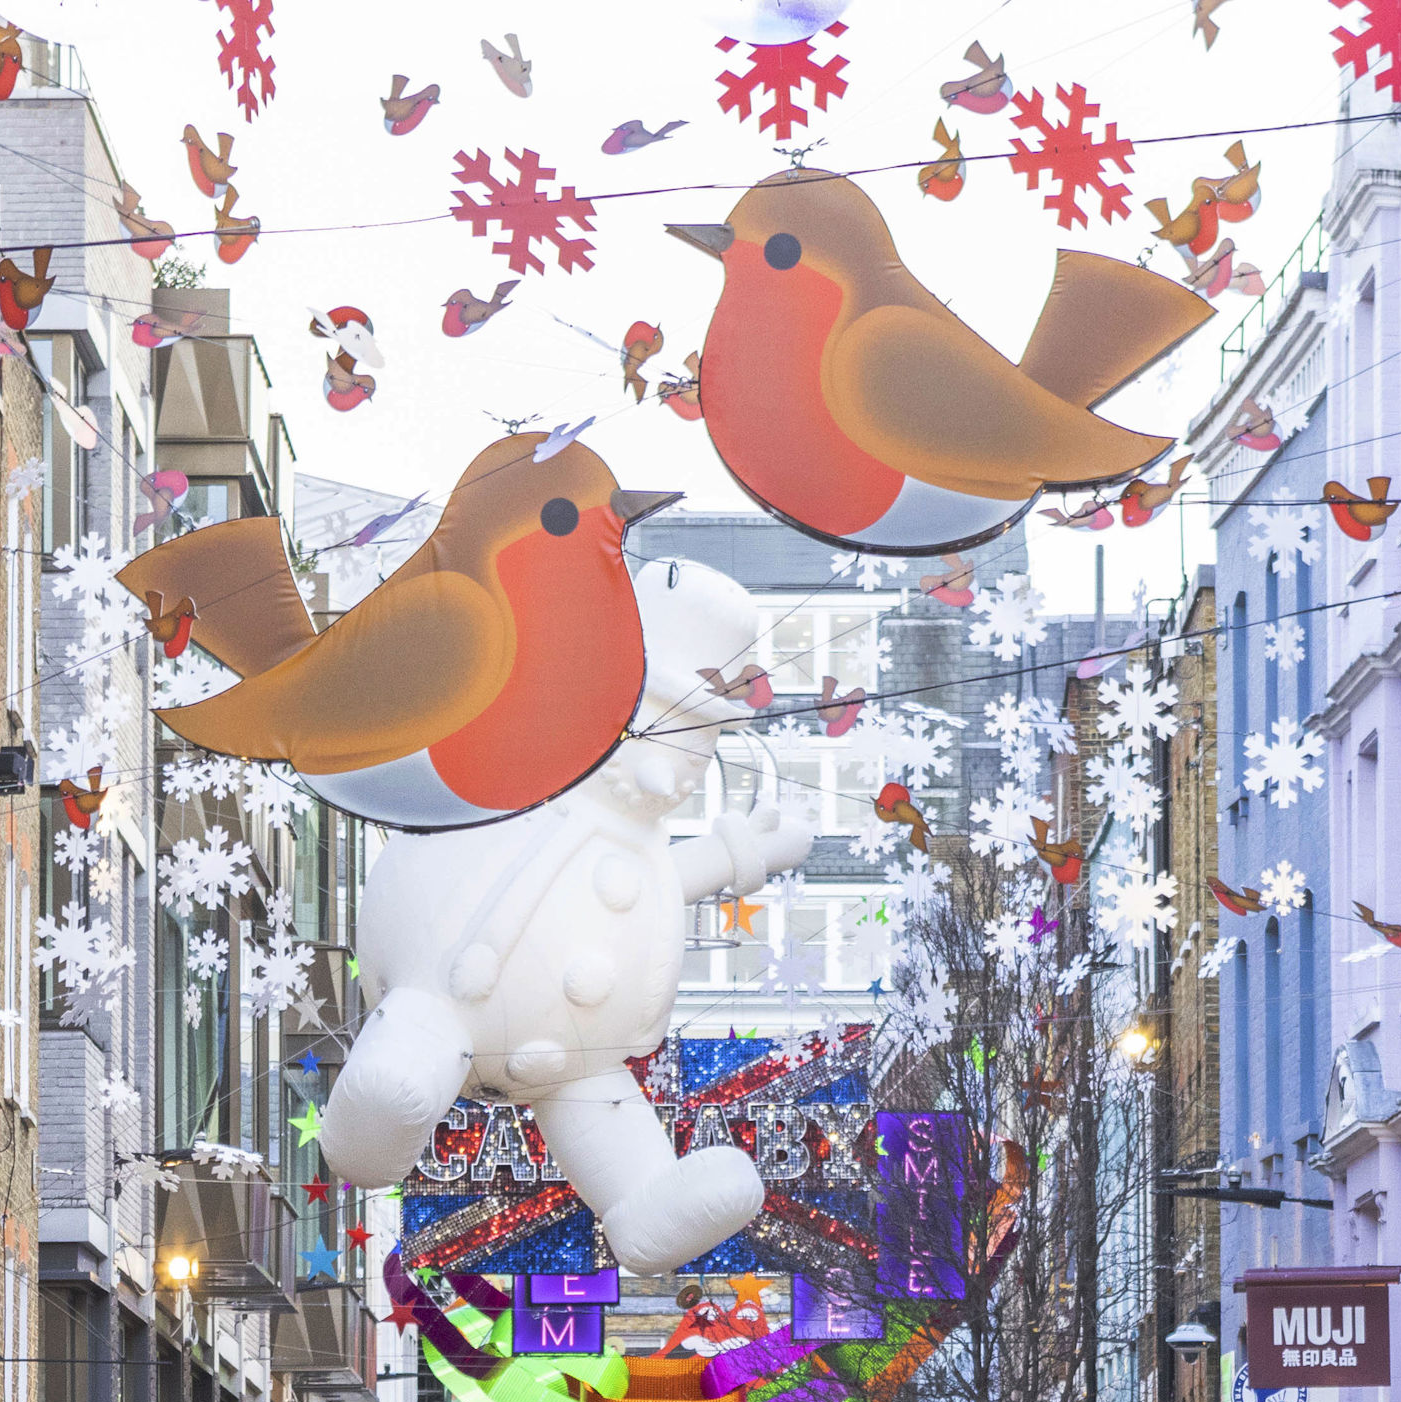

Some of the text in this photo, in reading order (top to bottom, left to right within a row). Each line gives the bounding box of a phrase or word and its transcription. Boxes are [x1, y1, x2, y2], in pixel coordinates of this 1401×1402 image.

[415, 1102, 873, 1182] CAABY
[1272, 1305, 1366, 1346] MUJI
[1281, 1347, 1358, 1368] 無印良品
